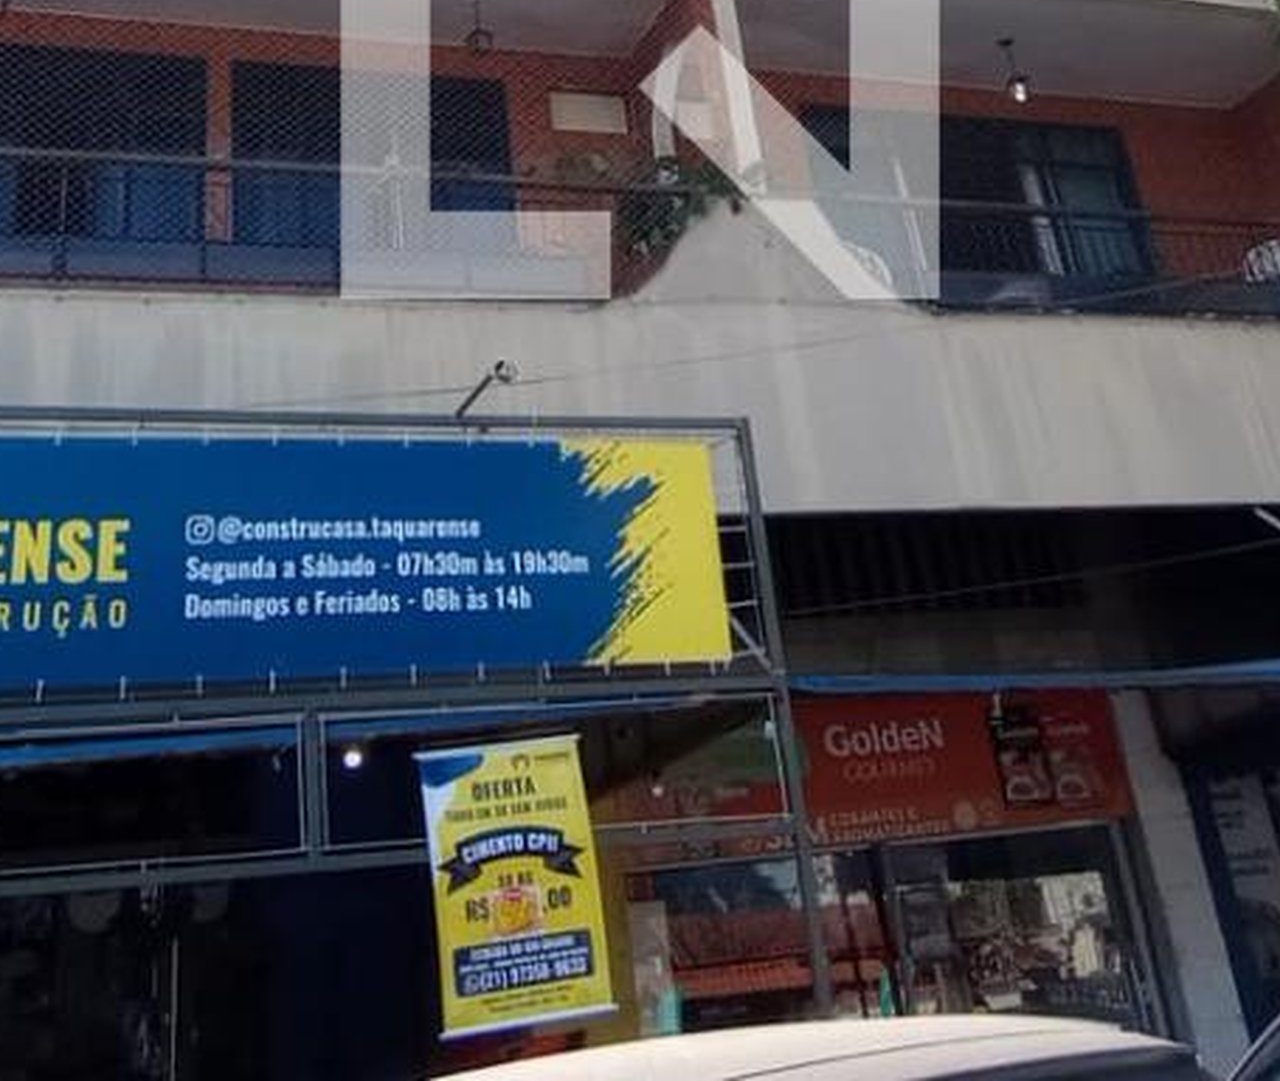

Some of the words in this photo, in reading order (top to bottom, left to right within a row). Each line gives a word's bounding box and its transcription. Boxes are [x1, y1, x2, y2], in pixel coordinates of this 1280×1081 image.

[219, 516, 481, 544] @construcasa.taquarense
[185, 555, 278, 585] Segunda
[283, 562, 296, 580] a
[300, 552, 376, 579] Sábado
[397, 551, 478, 578] 07h30m
[483, 549, 506, 576] às
[184, 592, 290, 622] Domingos
[295, 596, 309, 616] e
[313, 589, 401, 616] Feriados
[422, 586, 461, 613] 08h
[466, 584, 488, 611] às
[494, 585, 532, 611] 14h
[824, 717, 946, 758] GoldeN
[472, 777, 537, 801] OFERTA
[462, 833, 524, 864] CIMENTO
